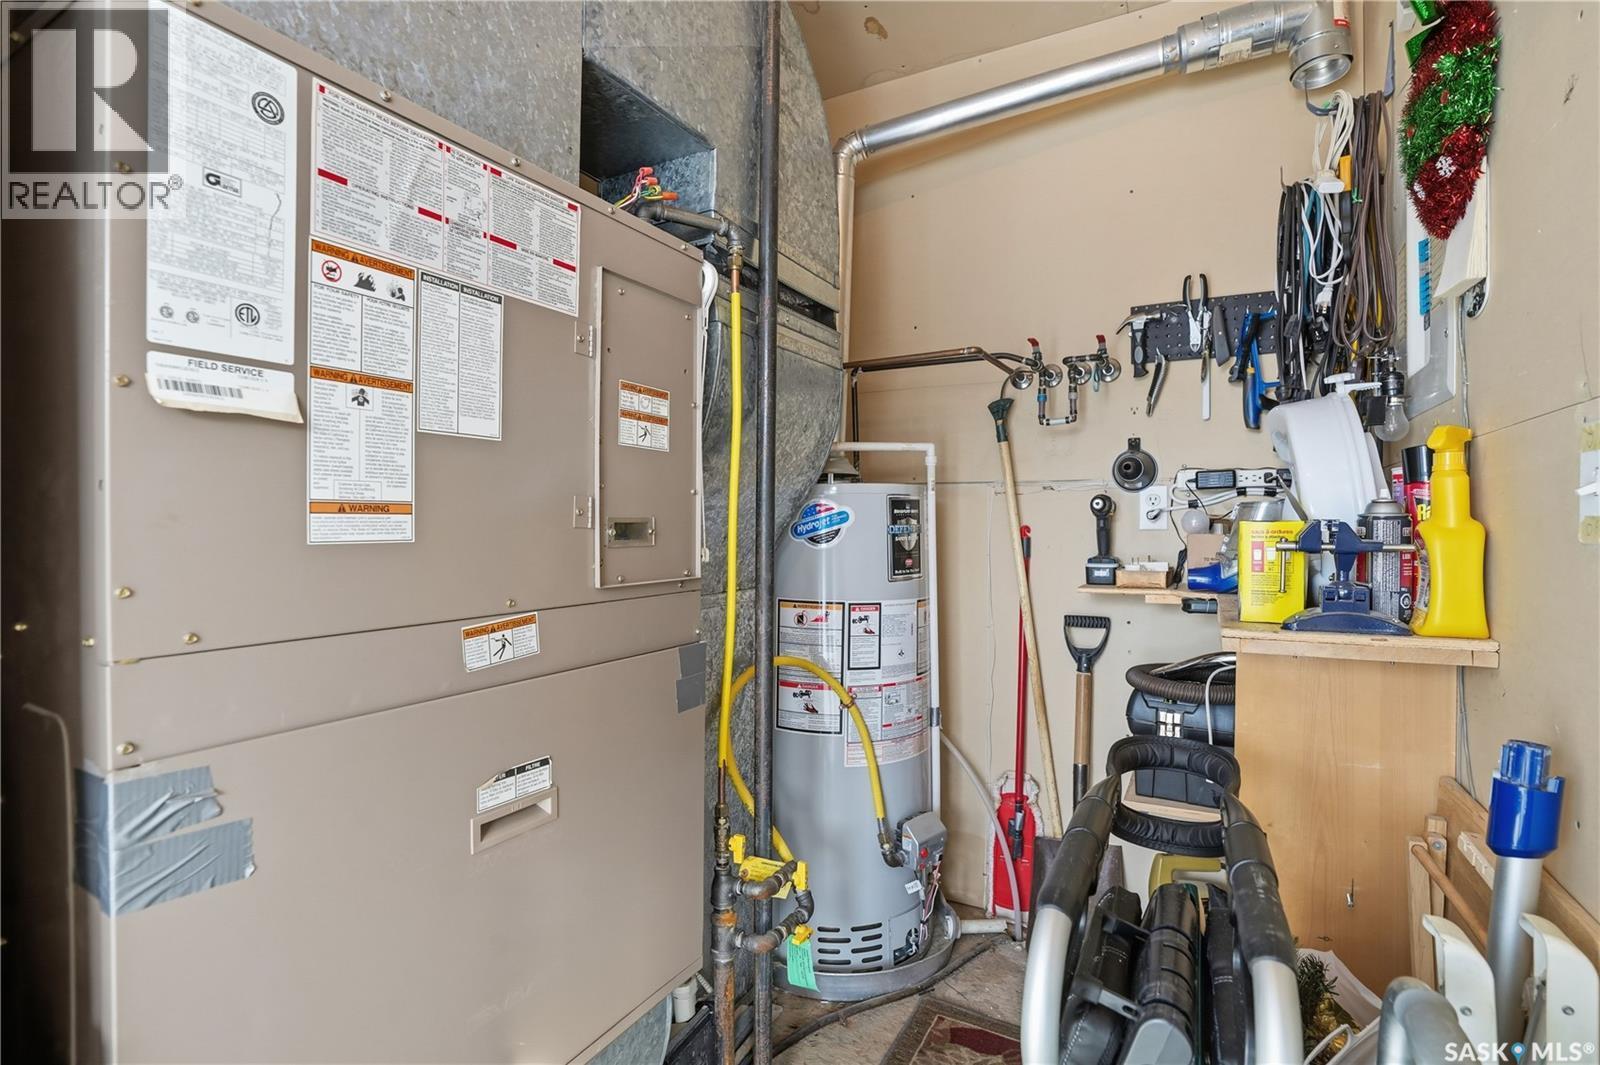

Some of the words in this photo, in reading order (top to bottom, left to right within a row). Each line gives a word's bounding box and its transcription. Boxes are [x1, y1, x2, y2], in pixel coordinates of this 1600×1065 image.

[314, 242, 350, 259] WARNING
[359, 255, 413, 278] AVERTISSEMENT
[422, 274, 459, 290] INSTALLATION
[463, 286, 499, 302] INSTALLATION
[187, 359, 219, 371] FIELD
[221, 363, 264, 377] SERVICE
[313, 369, 348, 382] WARNING
[358, 375, 412, 392] AVERTISSEMENT
[349, 504, 390, 513] WARNING
[796, 516, 830, 534] Hydrojet
